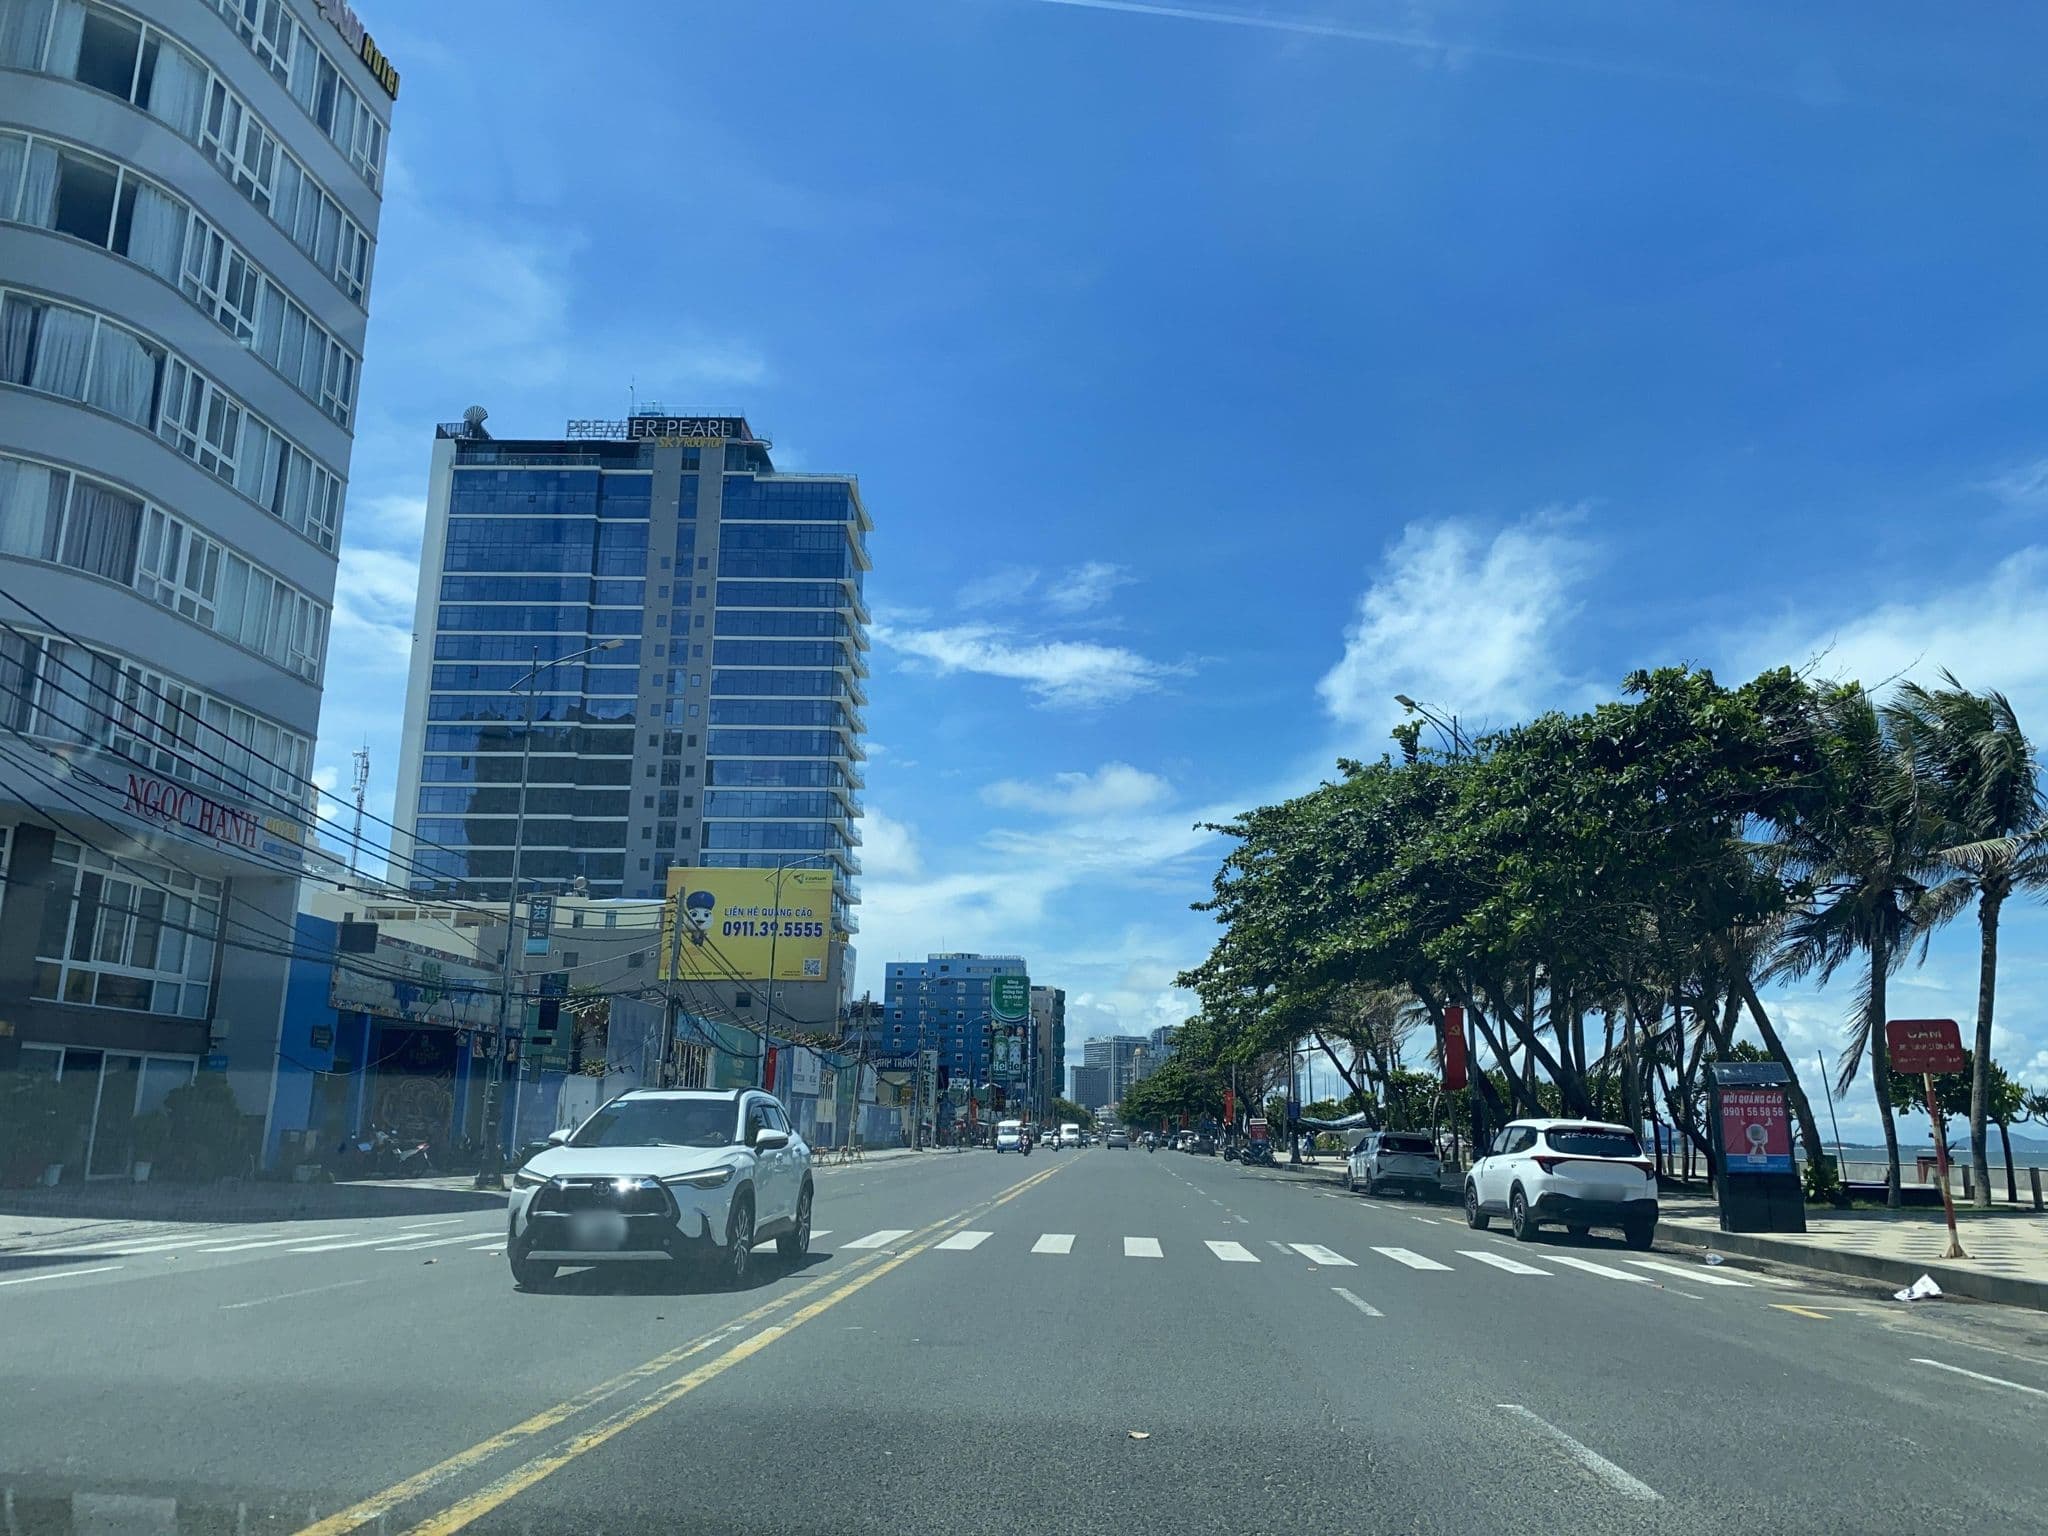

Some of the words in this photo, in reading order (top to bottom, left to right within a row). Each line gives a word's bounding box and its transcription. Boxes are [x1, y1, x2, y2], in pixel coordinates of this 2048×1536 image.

[666, 419, 731, 438] PEARL
[722, 921, 823, 937] 0911.39.5555
[1723, 1107, 1745, 1117] 0901
